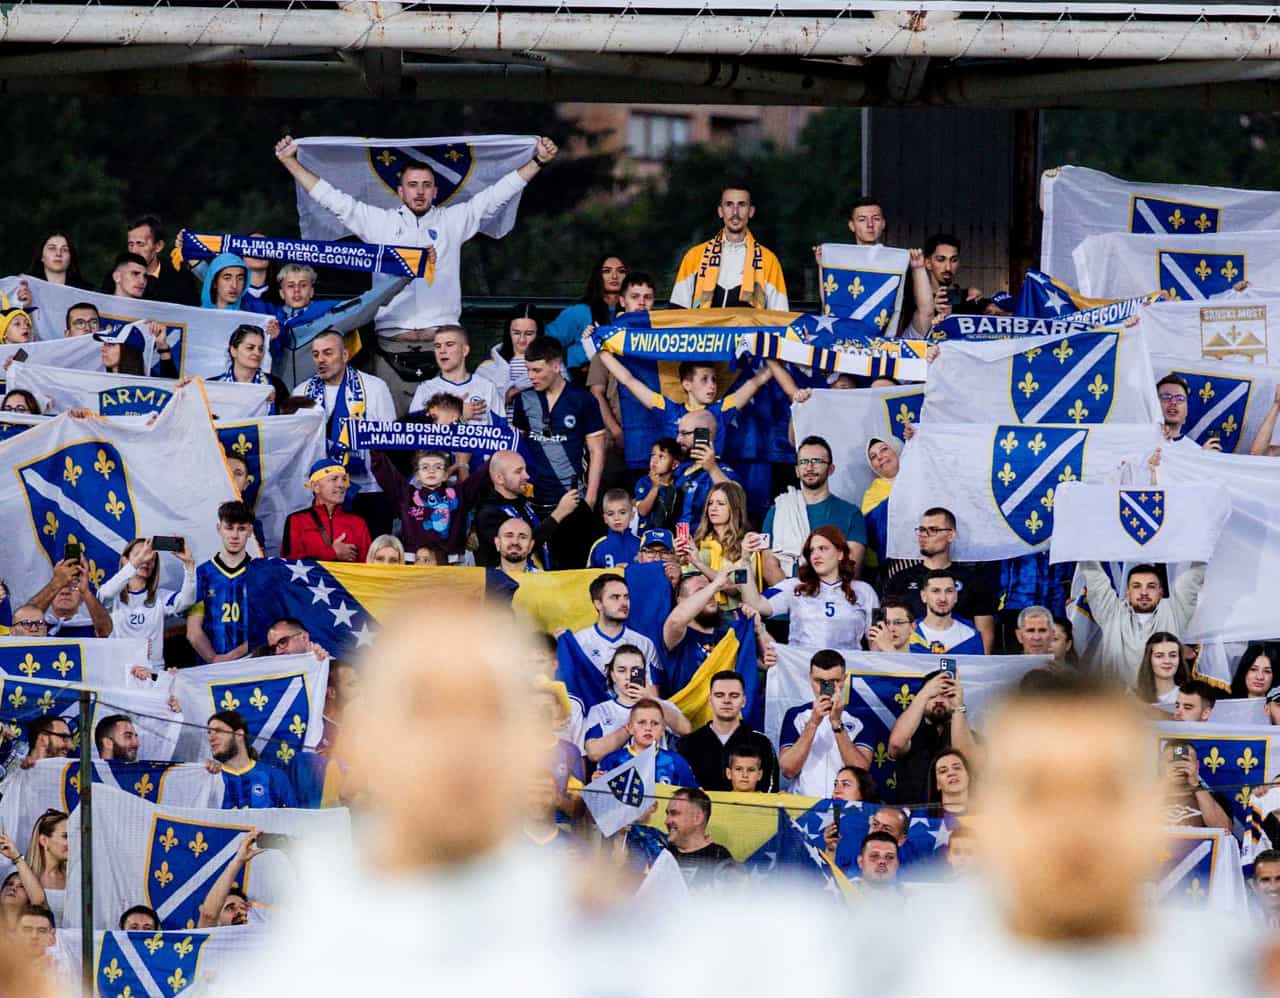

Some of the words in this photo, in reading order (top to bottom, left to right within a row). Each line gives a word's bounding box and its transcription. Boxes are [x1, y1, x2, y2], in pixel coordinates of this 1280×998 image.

[287, 250, 372, 268] HERCEGOVINO
[630, 333, 724, 354] HERCEGOVINA
[358, 421, 402, 433] HAJMO
[418, 435, 508, 450] HERCEGOVINO
[221, 602, 240, 623] 20
[825, 601, 835, 618] 5
[130, 613, 145, 625] 20
